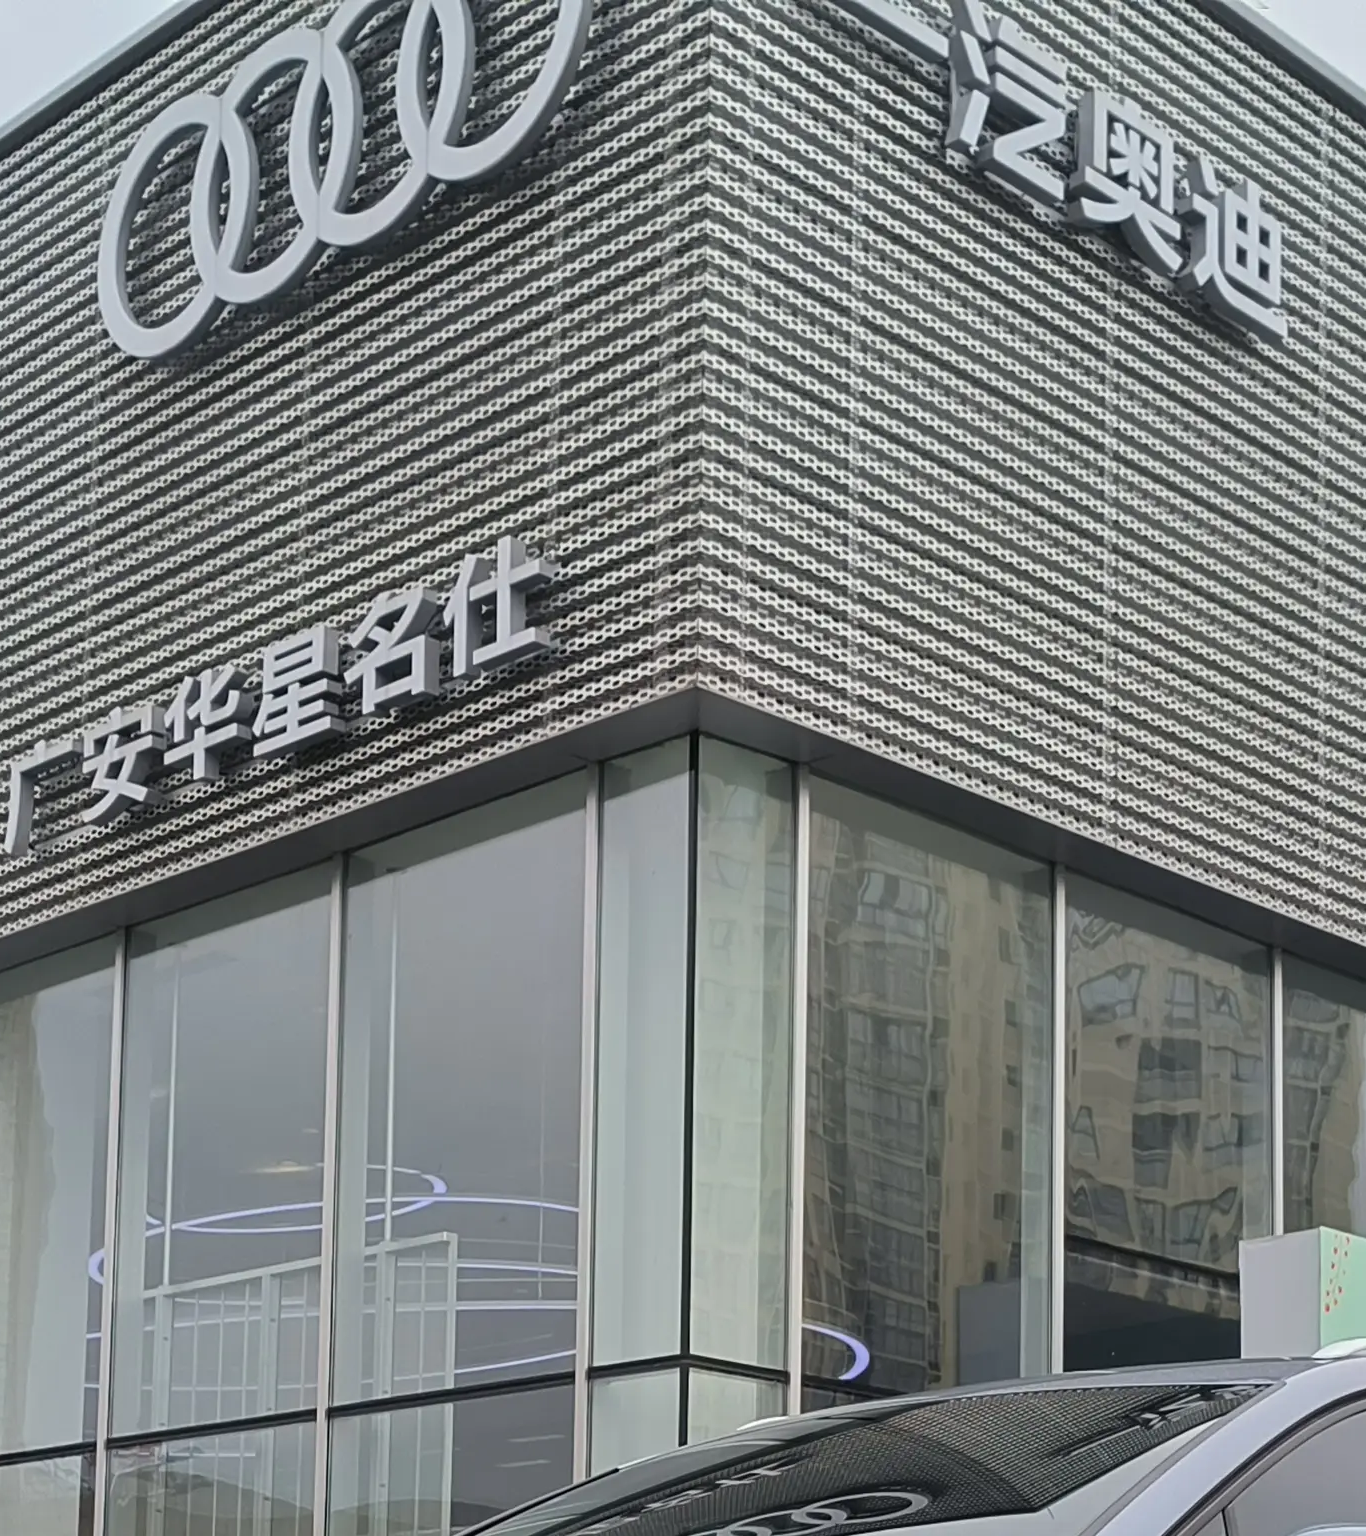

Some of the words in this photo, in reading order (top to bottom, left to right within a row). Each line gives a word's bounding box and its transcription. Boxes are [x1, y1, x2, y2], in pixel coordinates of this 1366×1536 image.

[3, 534, 559, 858] 广安华星名仕
